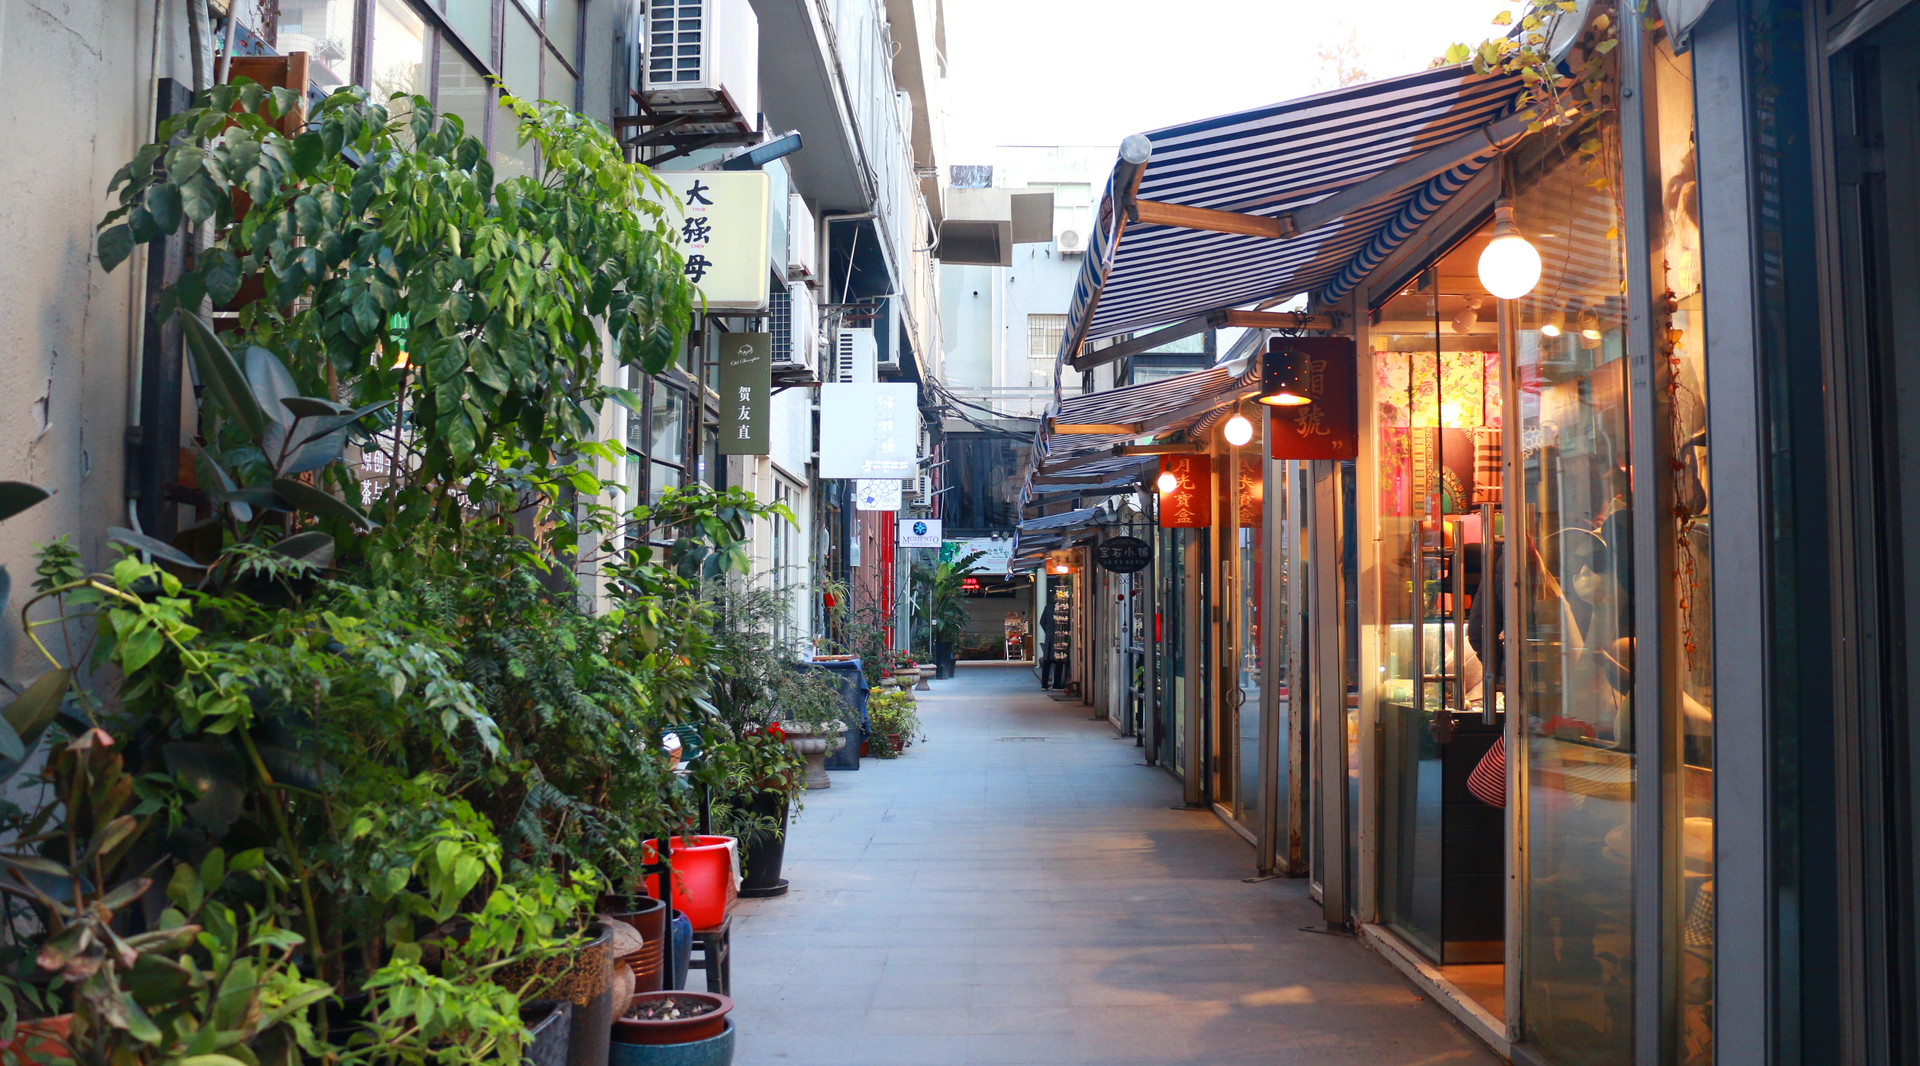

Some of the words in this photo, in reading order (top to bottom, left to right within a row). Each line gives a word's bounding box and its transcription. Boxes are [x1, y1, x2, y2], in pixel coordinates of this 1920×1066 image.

[737, 386, 751, 440] 贺友直
[1173, 458, 1196, 524] 月光寶盒
[902, 536, 939, 544] MOMENTO
